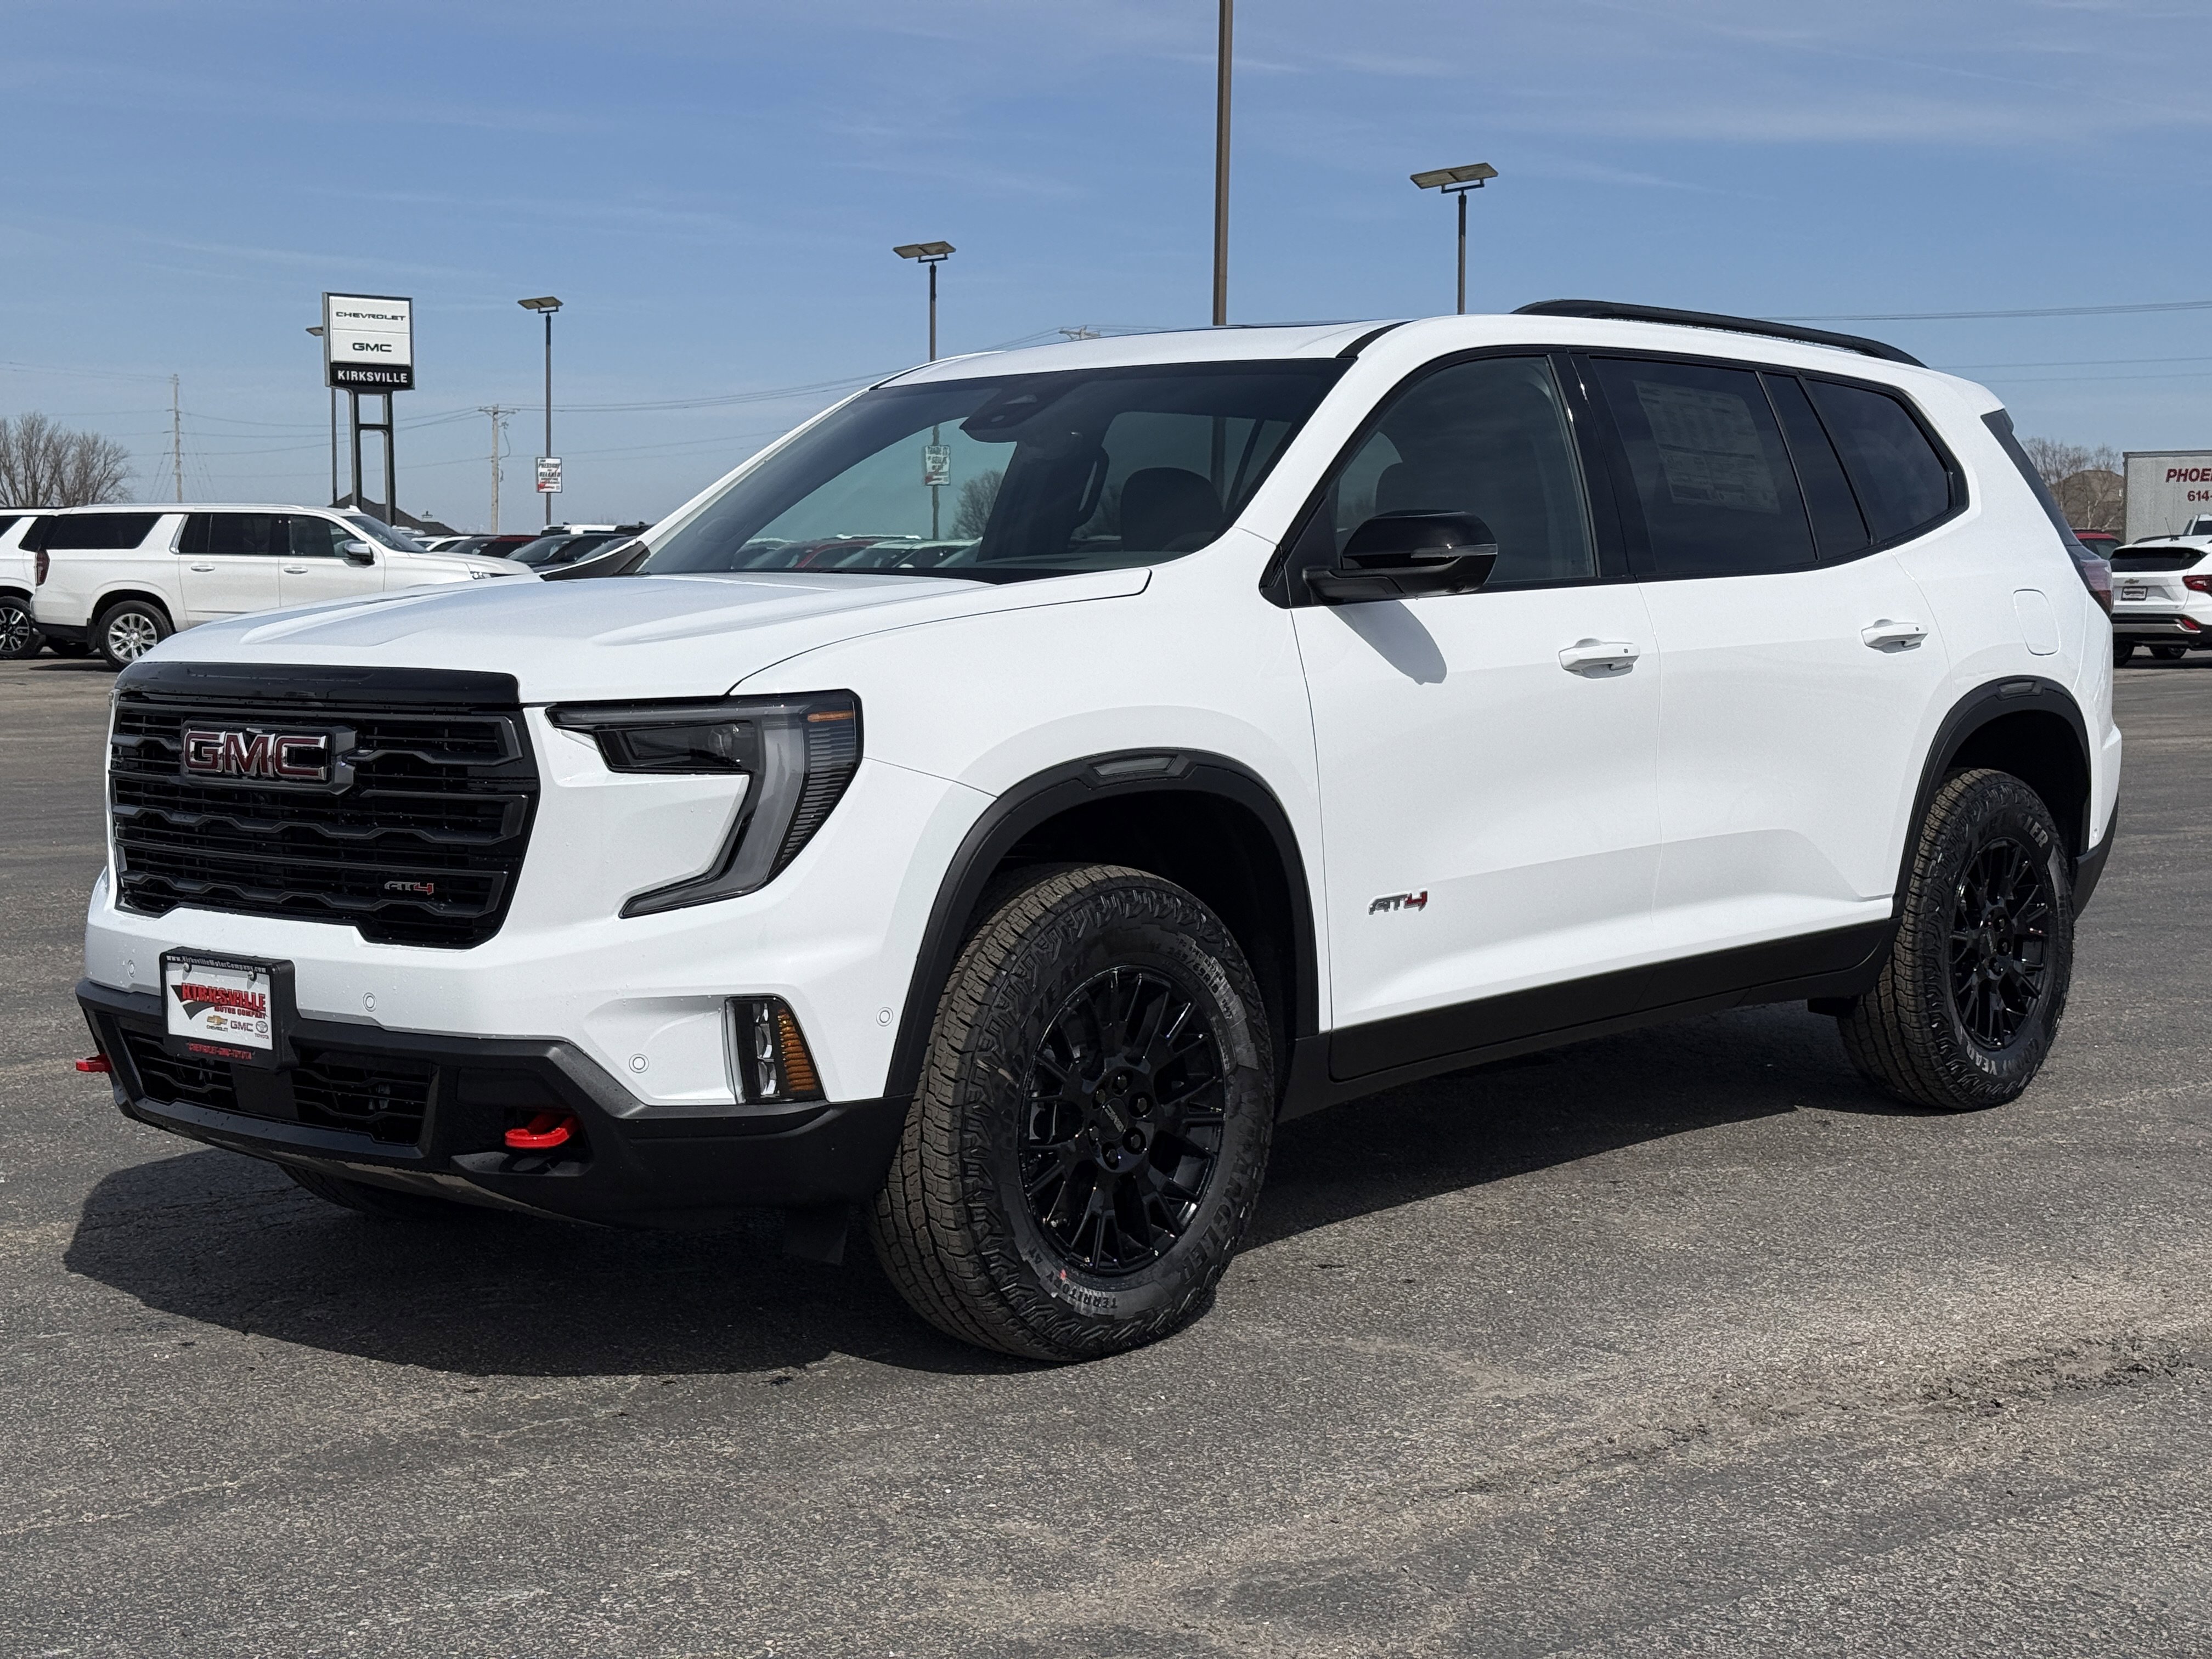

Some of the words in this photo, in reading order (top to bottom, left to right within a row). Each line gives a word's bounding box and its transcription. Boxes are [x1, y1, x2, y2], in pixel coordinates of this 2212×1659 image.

[336, 312, 406, 321] CHEVROLET
[352, 342, 392, 353] GMC
[337, 370, 408, 383] KIRKSVILLE
[2165, 468, 2212, 483] PHOE
[184, 728, 327, 781] GMC
[384, 881, 434, 895] AT4
[1368, 890, 1428, 916] AT4
[181, 982, 267, 1012] KIRKSVILLE
[214, 1006, 236, 1015] MOTOR
[230, 1020, 254, 1032] GMC
[1046, 1269, 1119, 1310] TERRITORY
